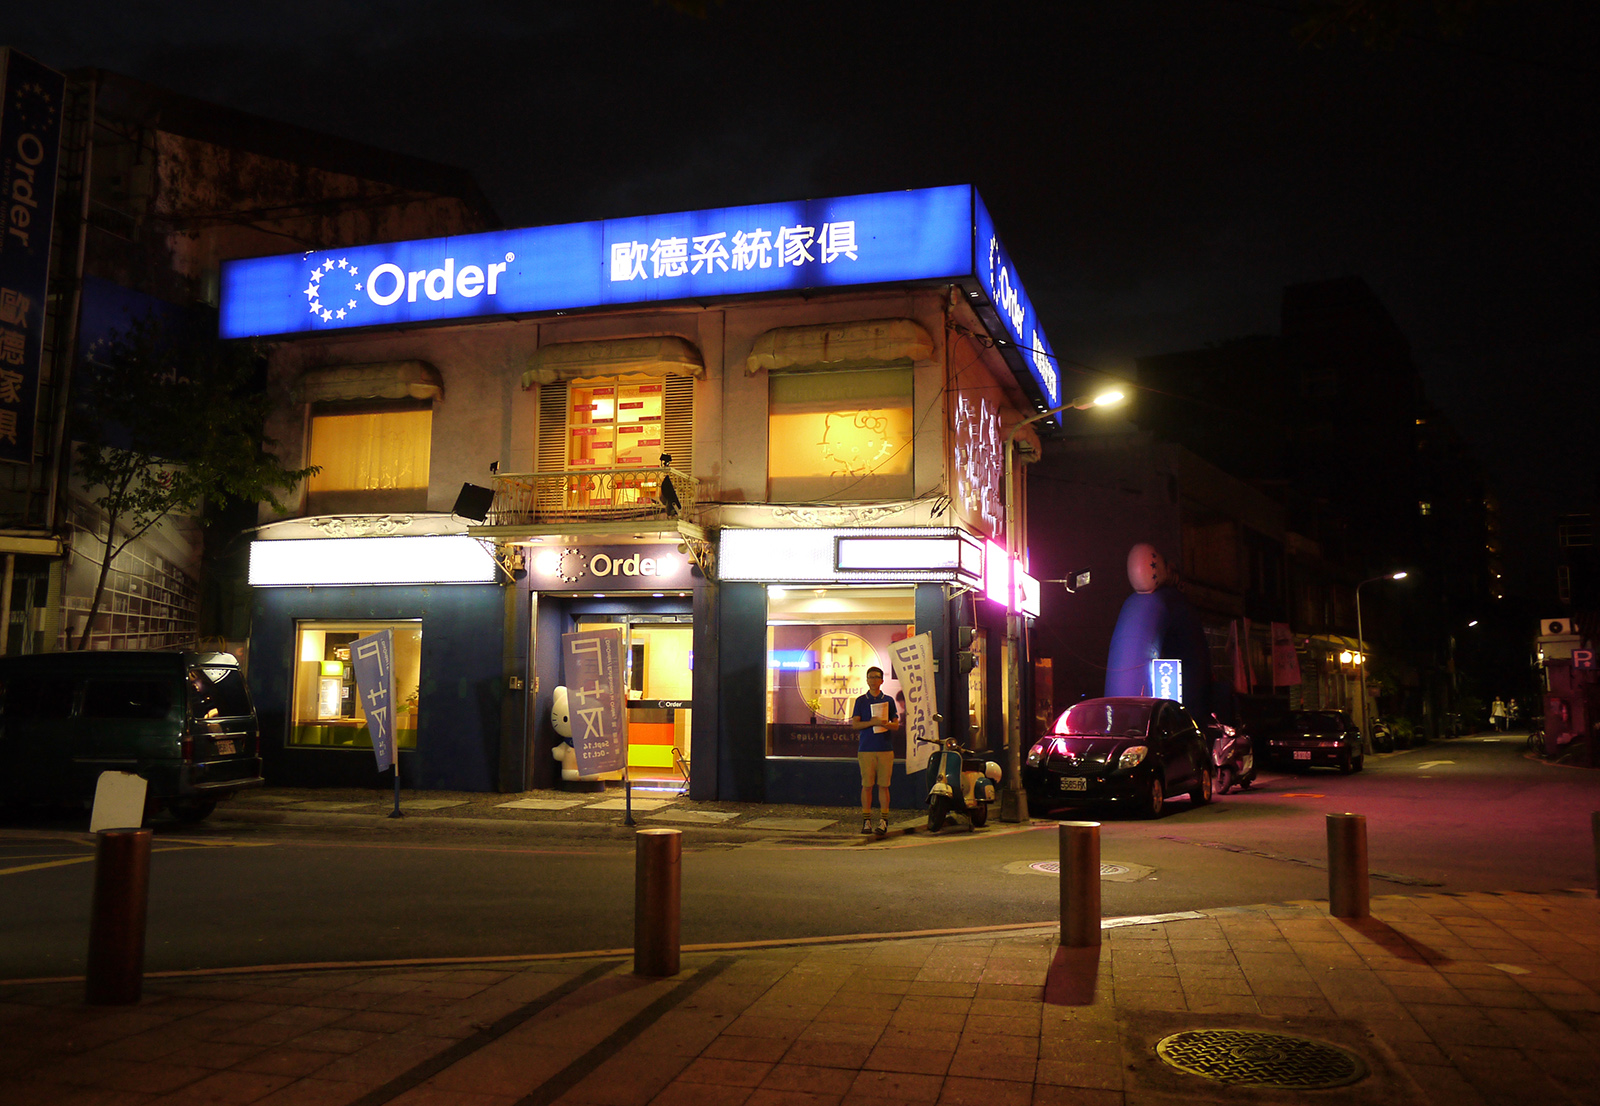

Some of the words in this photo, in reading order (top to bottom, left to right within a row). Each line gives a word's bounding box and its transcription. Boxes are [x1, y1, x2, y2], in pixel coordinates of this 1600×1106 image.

[10, 132, 45, 247] Order
[610, 220, 859, 282] 歐德系統傢俱
[1000, 265, 1025, 340] Order
[1574, 650, 1593, 668] P
